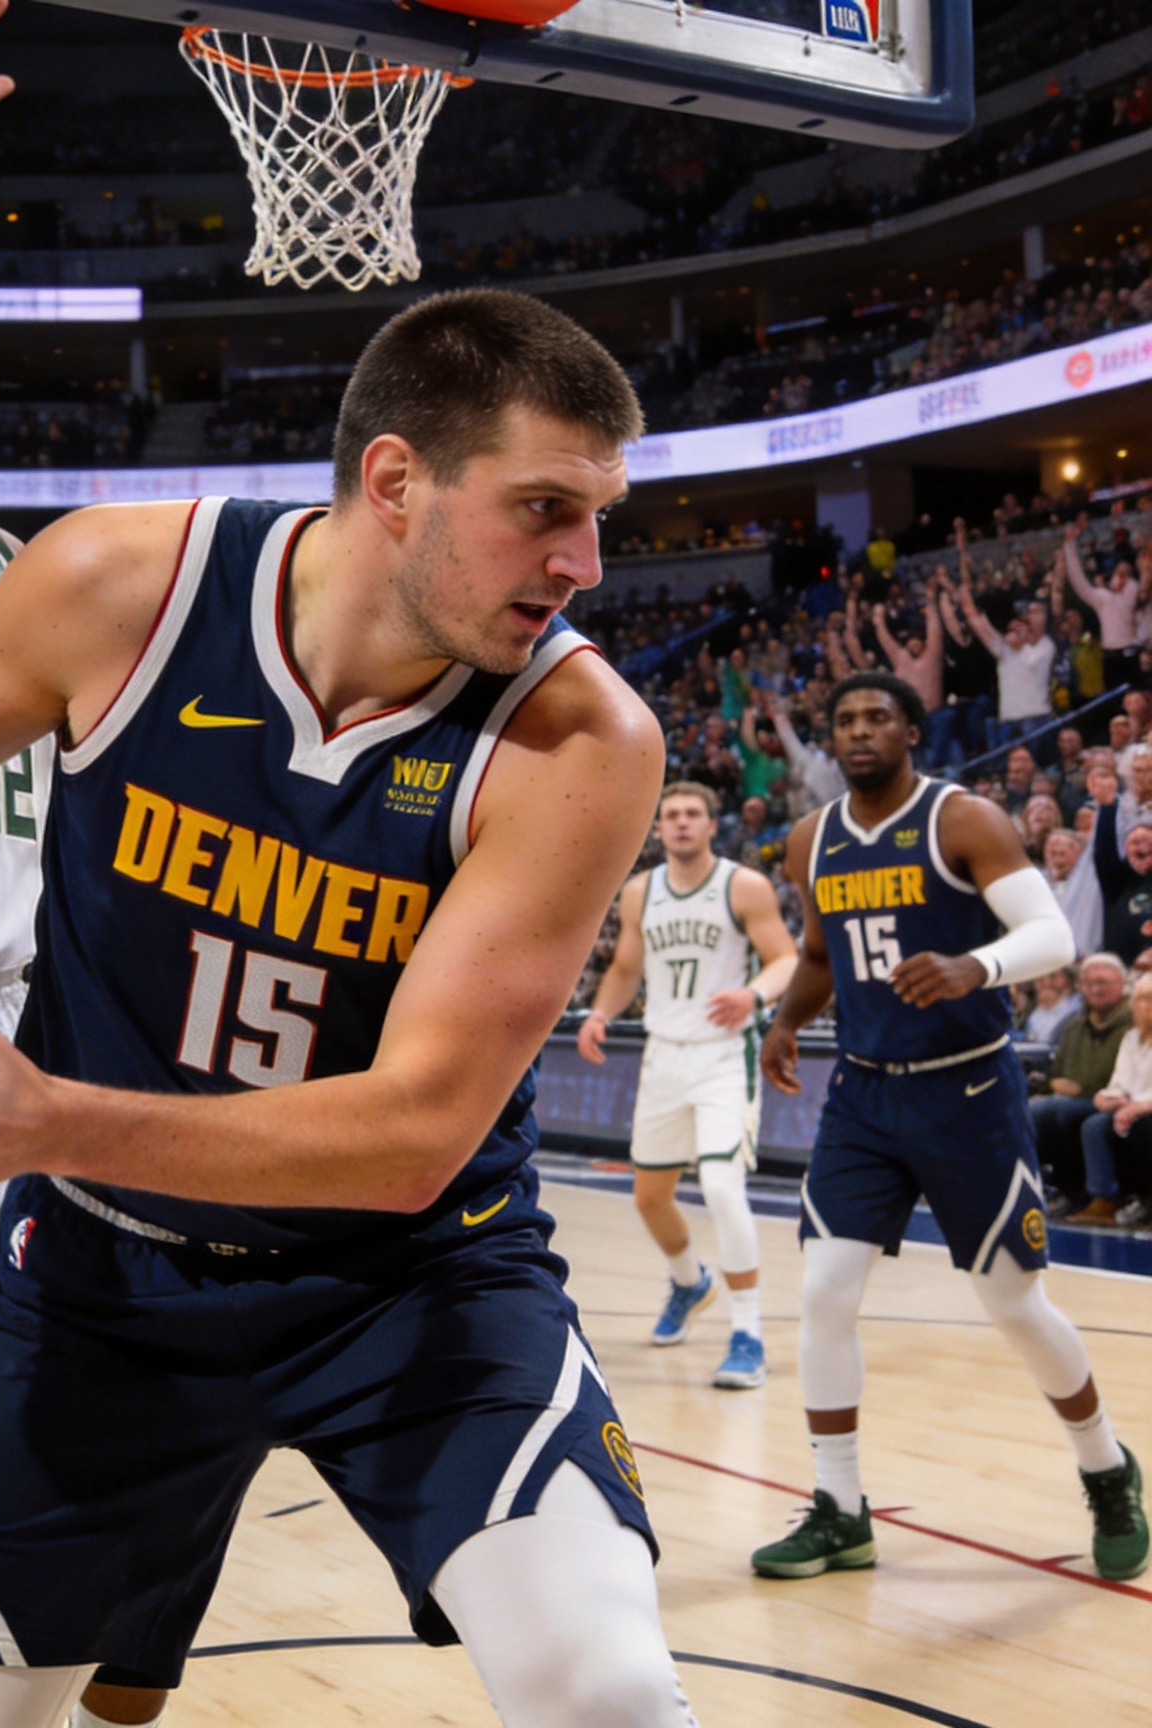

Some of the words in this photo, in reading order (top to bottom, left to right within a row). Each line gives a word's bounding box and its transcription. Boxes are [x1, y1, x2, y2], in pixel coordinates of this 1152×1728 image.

[113, 781, 430, 963] DENVER
[815, 865, 927, 914] DENVER
[844, 915, 903, 981] 15
[176, 928, 328, 1089] 15
